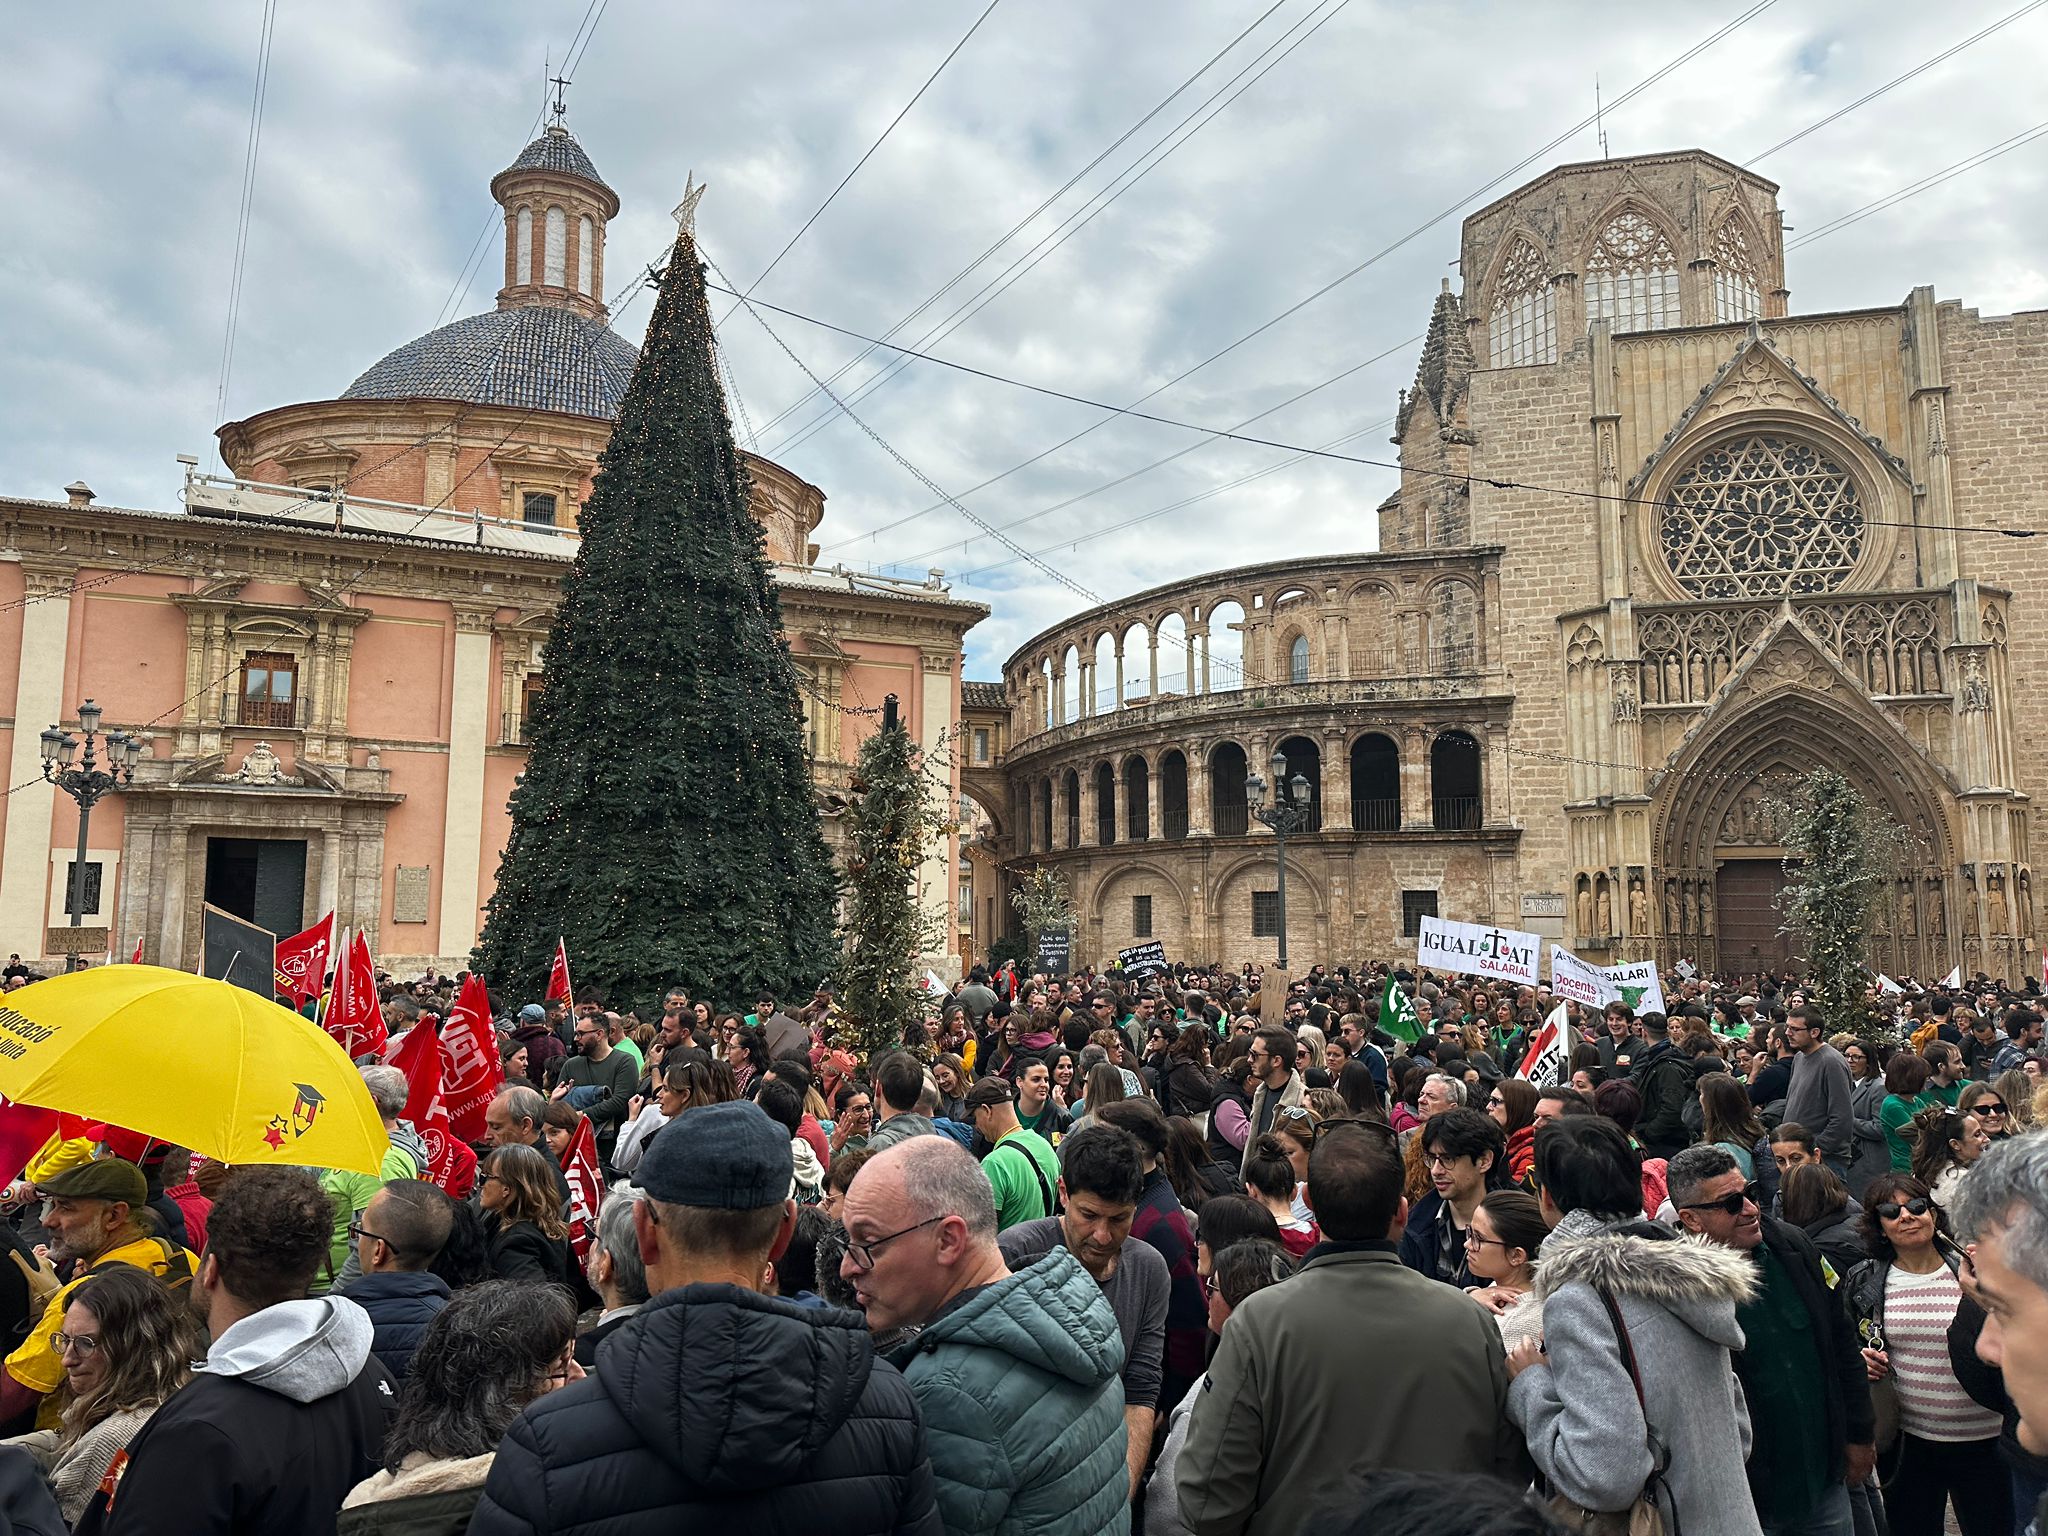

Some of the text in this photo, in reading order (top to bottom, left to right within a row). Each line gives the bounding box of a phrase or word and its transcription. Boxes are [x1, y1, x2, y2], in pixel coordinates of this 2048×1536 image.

[1480, 959, 1531, 978] SALARIAL
[1556, 973, 1597, 995] Docents
[439, 1013, 488, 1077] UGT
